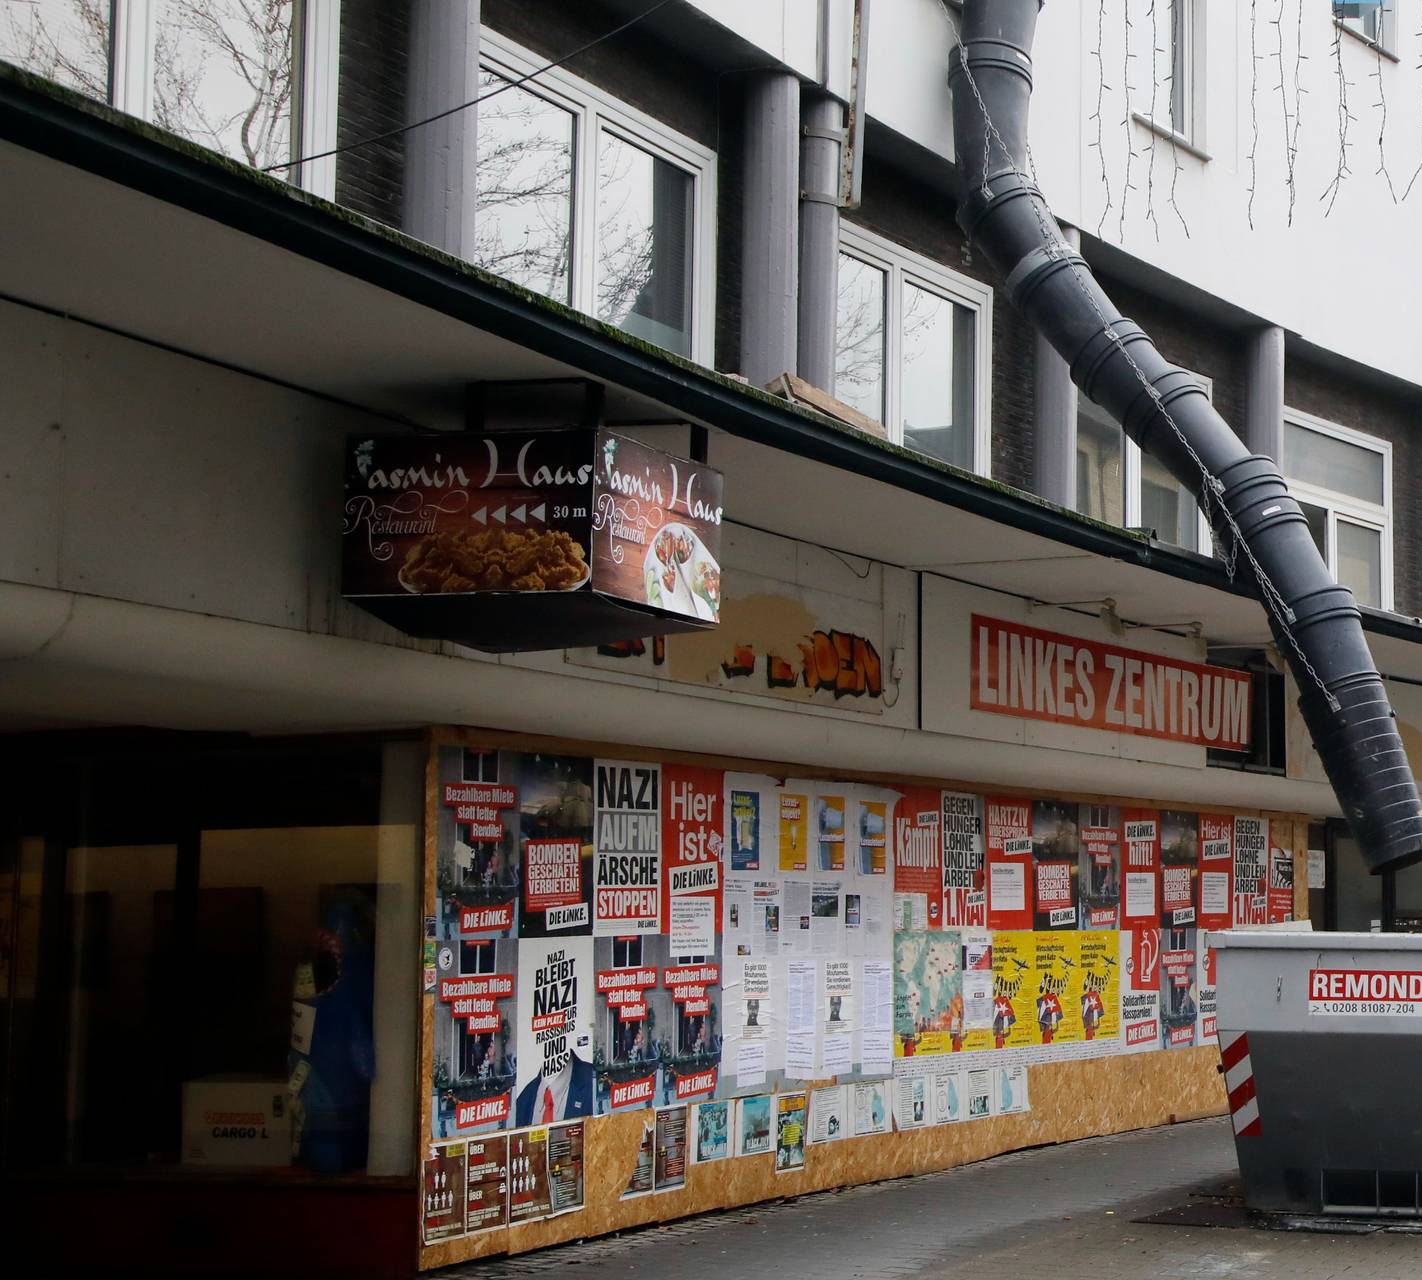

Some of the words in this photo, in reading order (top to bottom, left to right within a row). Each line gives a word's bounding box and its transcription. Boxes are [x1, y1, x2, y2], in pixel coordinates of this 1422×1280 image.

[480, 438, 593, 489] Haus
[667, 463, 723, 525] Haus
[553, 506, 568, 518] 30
[573, 508, 587, 518] m
[979, 626, 1095, 721] LINKES
[1105, 654, 1249, 745] ZENTRUM
[446, 786, 491, 803] Bezahlbare
[492, 788, 514, 803] Miete
[598, 766, 658, 810] NAZI
[671, 781, 716, 822] Hier
[944, 796, 974, 815] GEGEN
[457, 805, 475, 820] statt
[476, 806, 498, 821] fetter
[989, 805, 1019, 826] HARTZ
[1019, 807, 1029, 826] IV
[944, 814, 981, 834] HUNGER
[1127, 825, 1136, 838] DIE
[1201, 819, 1219, 839] Hier
[1220, 821, 1231, 839] ist
[1236, 819, 1260, 834] GEGEN
[679, 822, 707, 861] ist
[896, 817, 939, 872] Kämpft
[1006, 841, 1015, 852] DIE
[1204, 844, 1213, 856] DIE
[1235, 834, 1265, 850] HUNGER
[528, 844, 579, 864] BOMBEN
[944, 851, 964, 869] UND
[1129, 841, 1153, 866] hilft!
[528, 862, 579, 880] GESCHÄFTE
[597, 854, 658, 886] ÄRSCHE
[944, 869, 975, 888] ARBEIT
[1037, 864, 1069, 879] BOMBEN
[1235, 863, 1251, 878] UND
[528, 878, 580, 895] VERBIETEN!
[673, 871, 688, 890] DIE
[1234, 879, 1258, 893] ARBEIT
[598, 890, 656, 917] STOPPEN
[463, 913, 478, 929] DIE
[549, 911, 561, 926] DIE
[1052, 911, 1060, 922] DIE
[547, 950, 564, 965] NAZI
[535, 958, 576, 988] BLEIBT
[599, 972, 636, 988] Bezahlbare
[637, 970, 656, 985] Miete
[442, 980, 487, 997] Bezahlbare
[489, 979, 511, 993] Miete
[534, 977, 577, 1016] NAZI
[608, 990, 623, 1003] statt
[454, 999, 472, 1014] statt
[472, 998, 494, 1013] fetter
[1332, 1003, 1357, 1013] 0208
[1361, 1004, 1415, 1014] 81087-204
[469, 1015, 499, 1030] Rendite!
[536, 1020, 575, 1044] RASSISMUS
[1128, 1028, 1138, 1041] DIE
[544, 1036, 567, 1059] UND
[543, 1053, 569, 1078] HASS
[679, 1079, 690, 1095] DIE
[613, 1088, 627, 1104] DIE
[459, 1108, 475, 1125] DIE
[212, 1127, 257, 1139] CARGO
[261, 1127, 269, 1139] L
[469, 1142, 485, 1156] ÜBER
